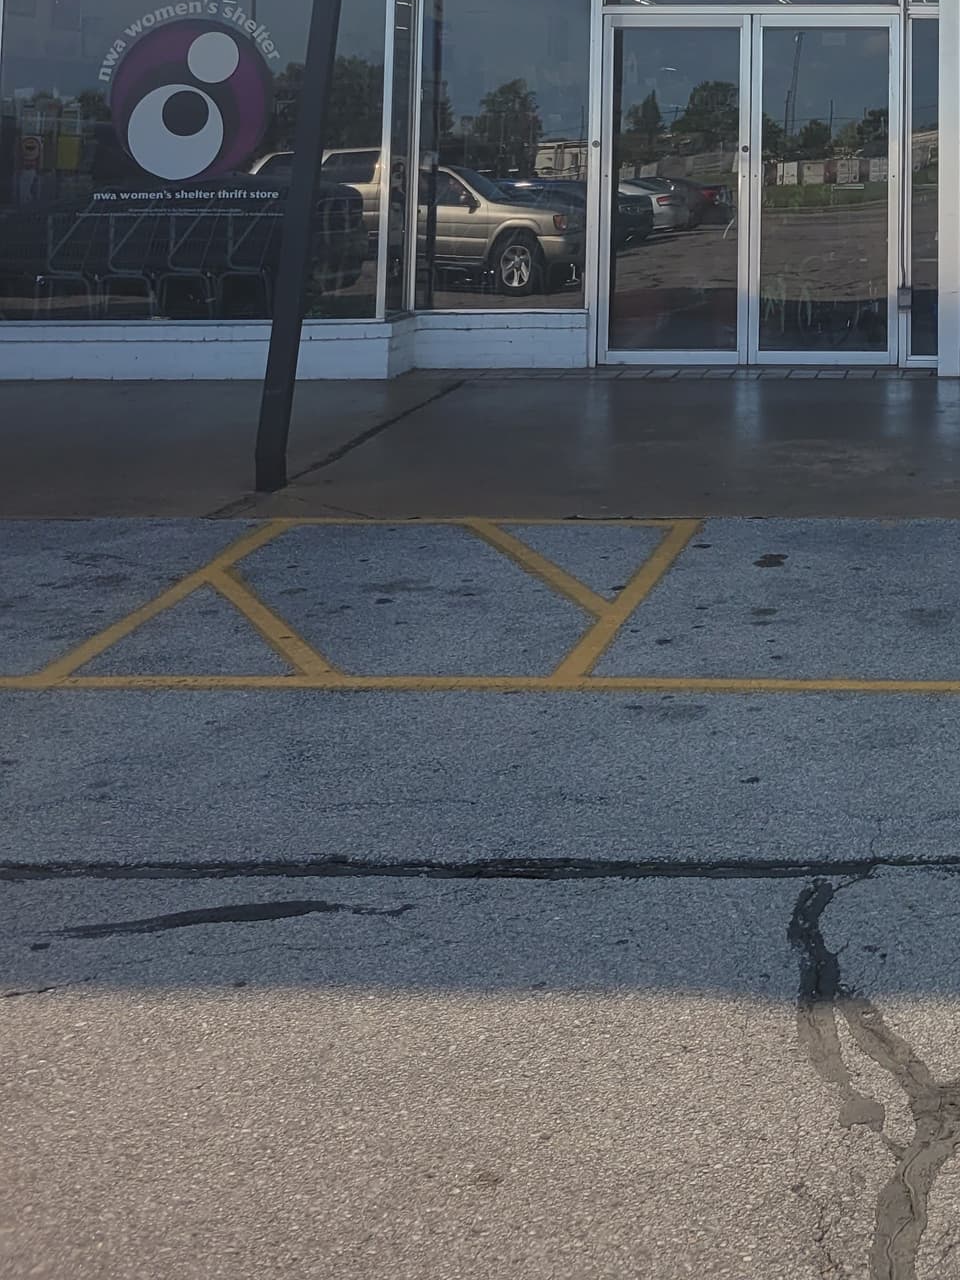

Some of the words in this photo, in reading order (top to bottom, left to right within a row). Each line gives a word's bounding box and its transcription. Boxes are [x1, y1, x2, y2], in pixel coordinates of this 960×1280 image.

[99, 39, 127, 82] nwa
[222, 6, 281, 60] shelter
[93, 191, 117, 201] nwa
[119, 189, 172, 201] women's
[175, 189, 215, 200] shelter
[217, 189, 248, 200] thrift
[250, 190, 280, 200] store
